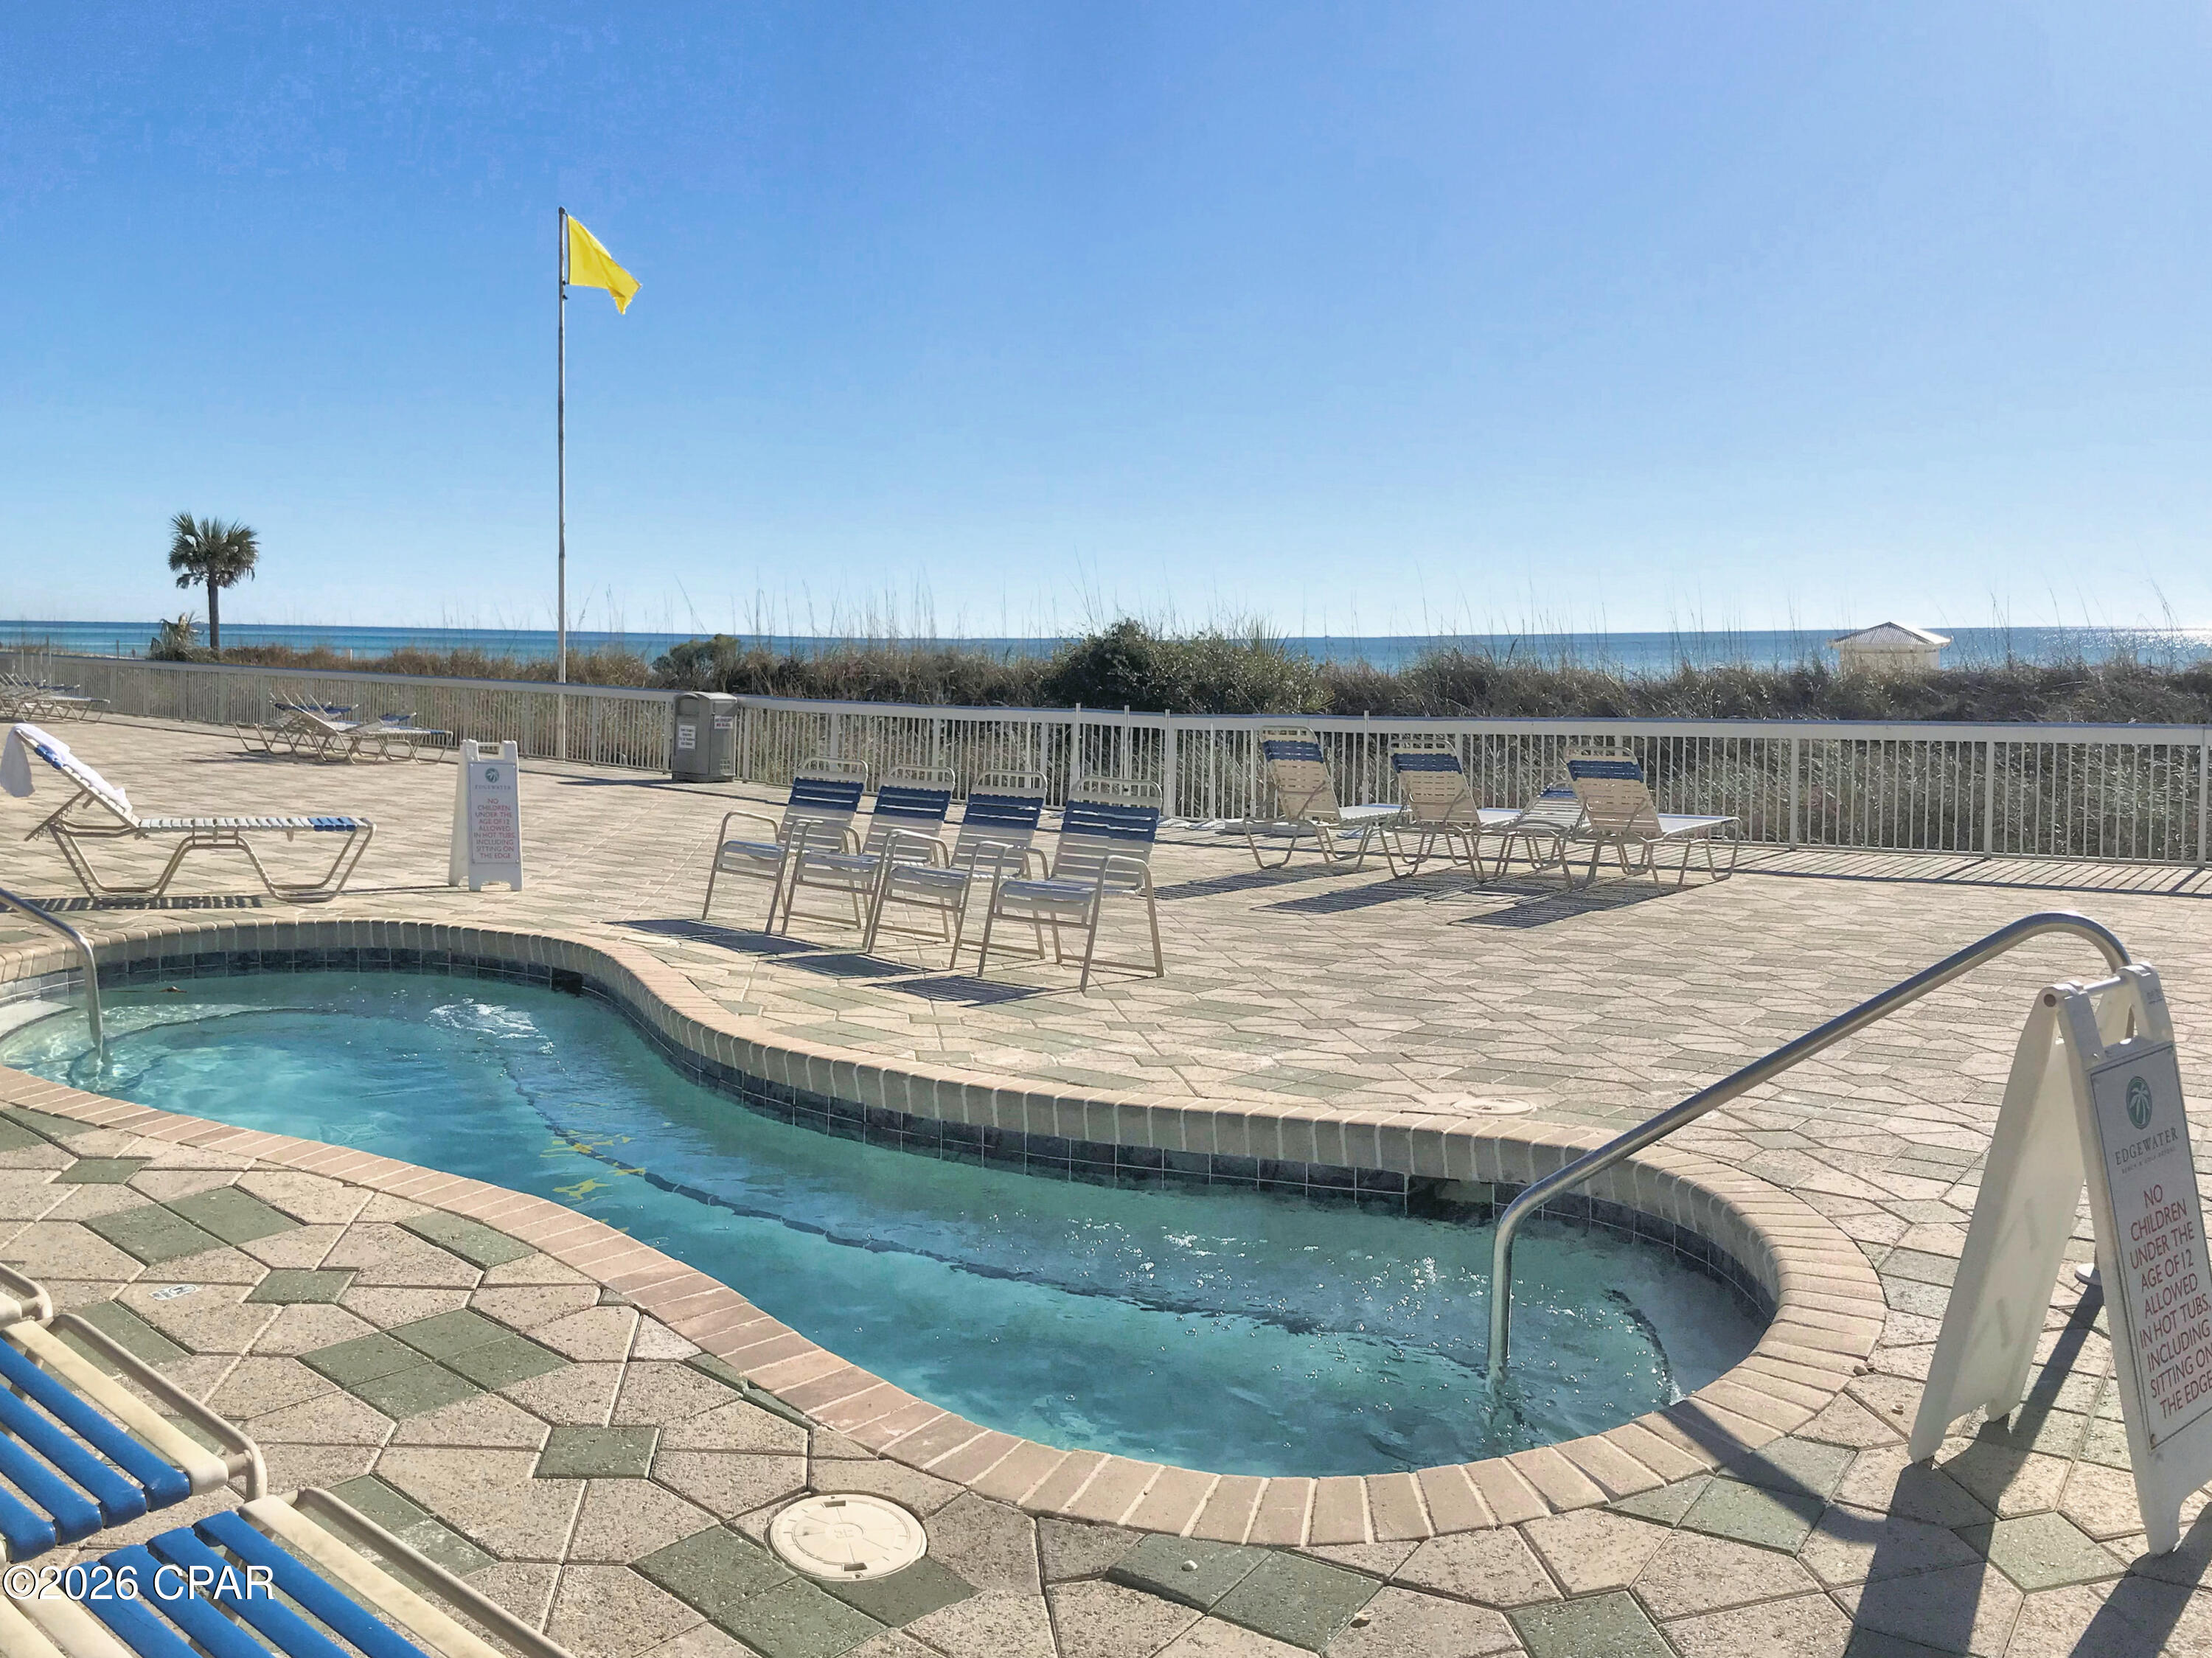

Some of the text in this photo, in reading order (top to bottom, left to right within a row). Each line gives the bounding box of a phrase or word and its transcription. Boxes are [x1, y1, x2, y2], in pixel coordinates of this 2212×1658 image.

[2115, 1126, 2179, 1166] EDGEWATER
[2143, 1184, 2163, 1209] NO
[2130, 1197, 2188, 1242] CHILDREN
[2129, 1221, 2195, 1270] UNDER THE
[2141, 1248, 2194, 1294] AGE OF 12
[2145, 1272, 2198, 1320] ALLOWED
[2139, 1325, 2153, 1349] IN
[2153, 1309, 2177, 1340] HOT
[2147, 1319, 2211, 1373] INCLUDING
[2150, 1356, 2194, 1398] SITTING
[2160, 1390, 2183, 1419] THE
